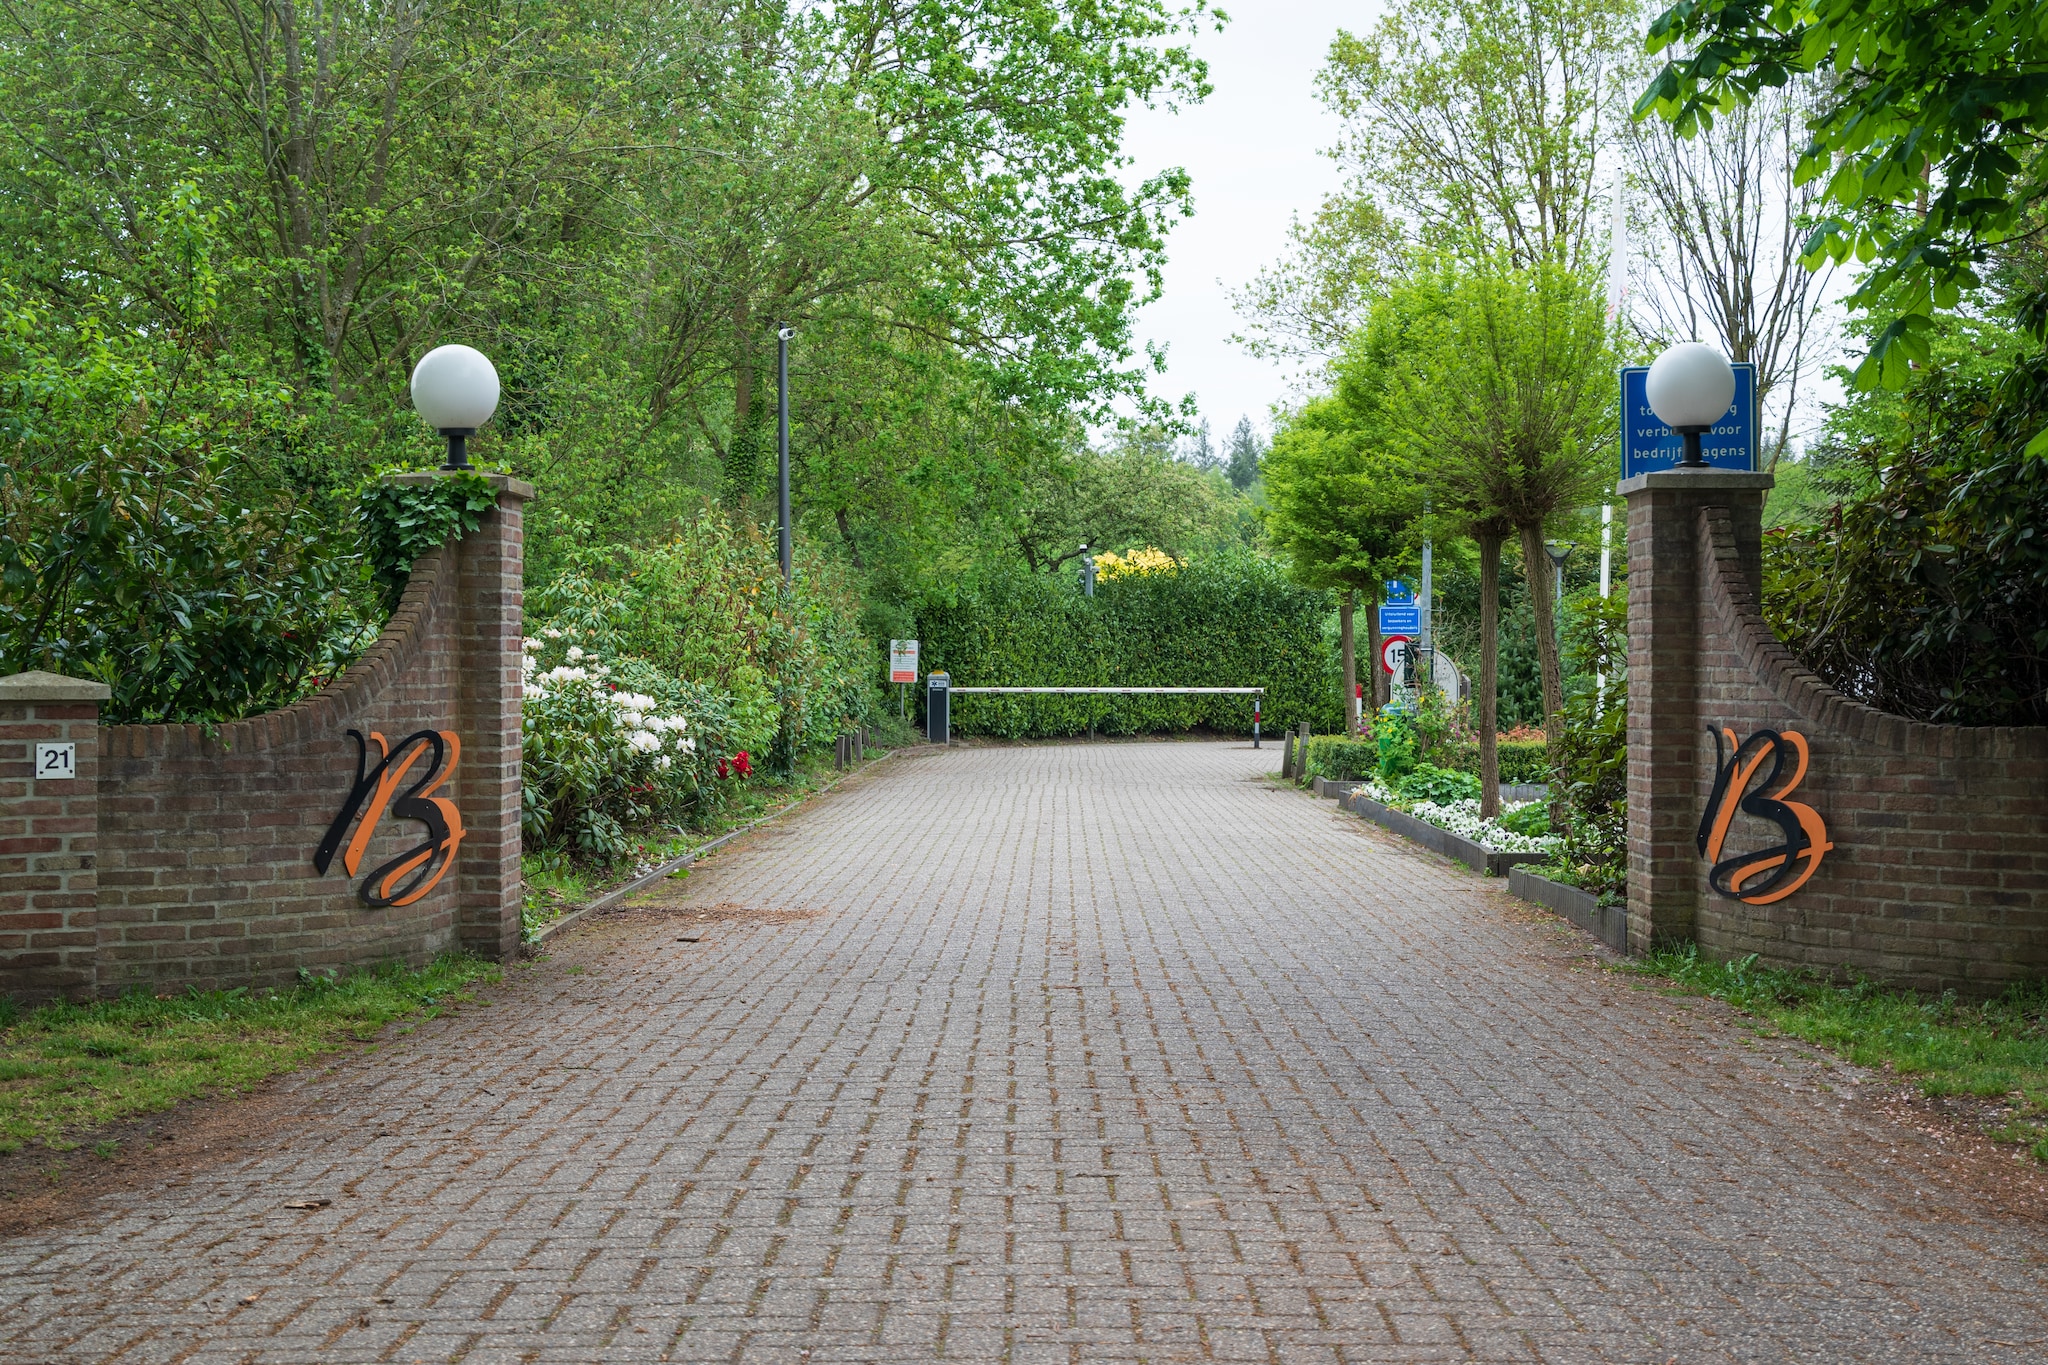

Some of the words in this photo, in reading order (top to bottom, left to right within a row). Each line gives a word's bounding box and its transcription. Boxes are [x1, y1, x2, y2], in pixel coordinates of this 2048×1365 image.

[1711, 425, 1742, 435] voor
[1634, 447, 1746, 461] bedrijfagens
[45, 749, 68, 769] 21
